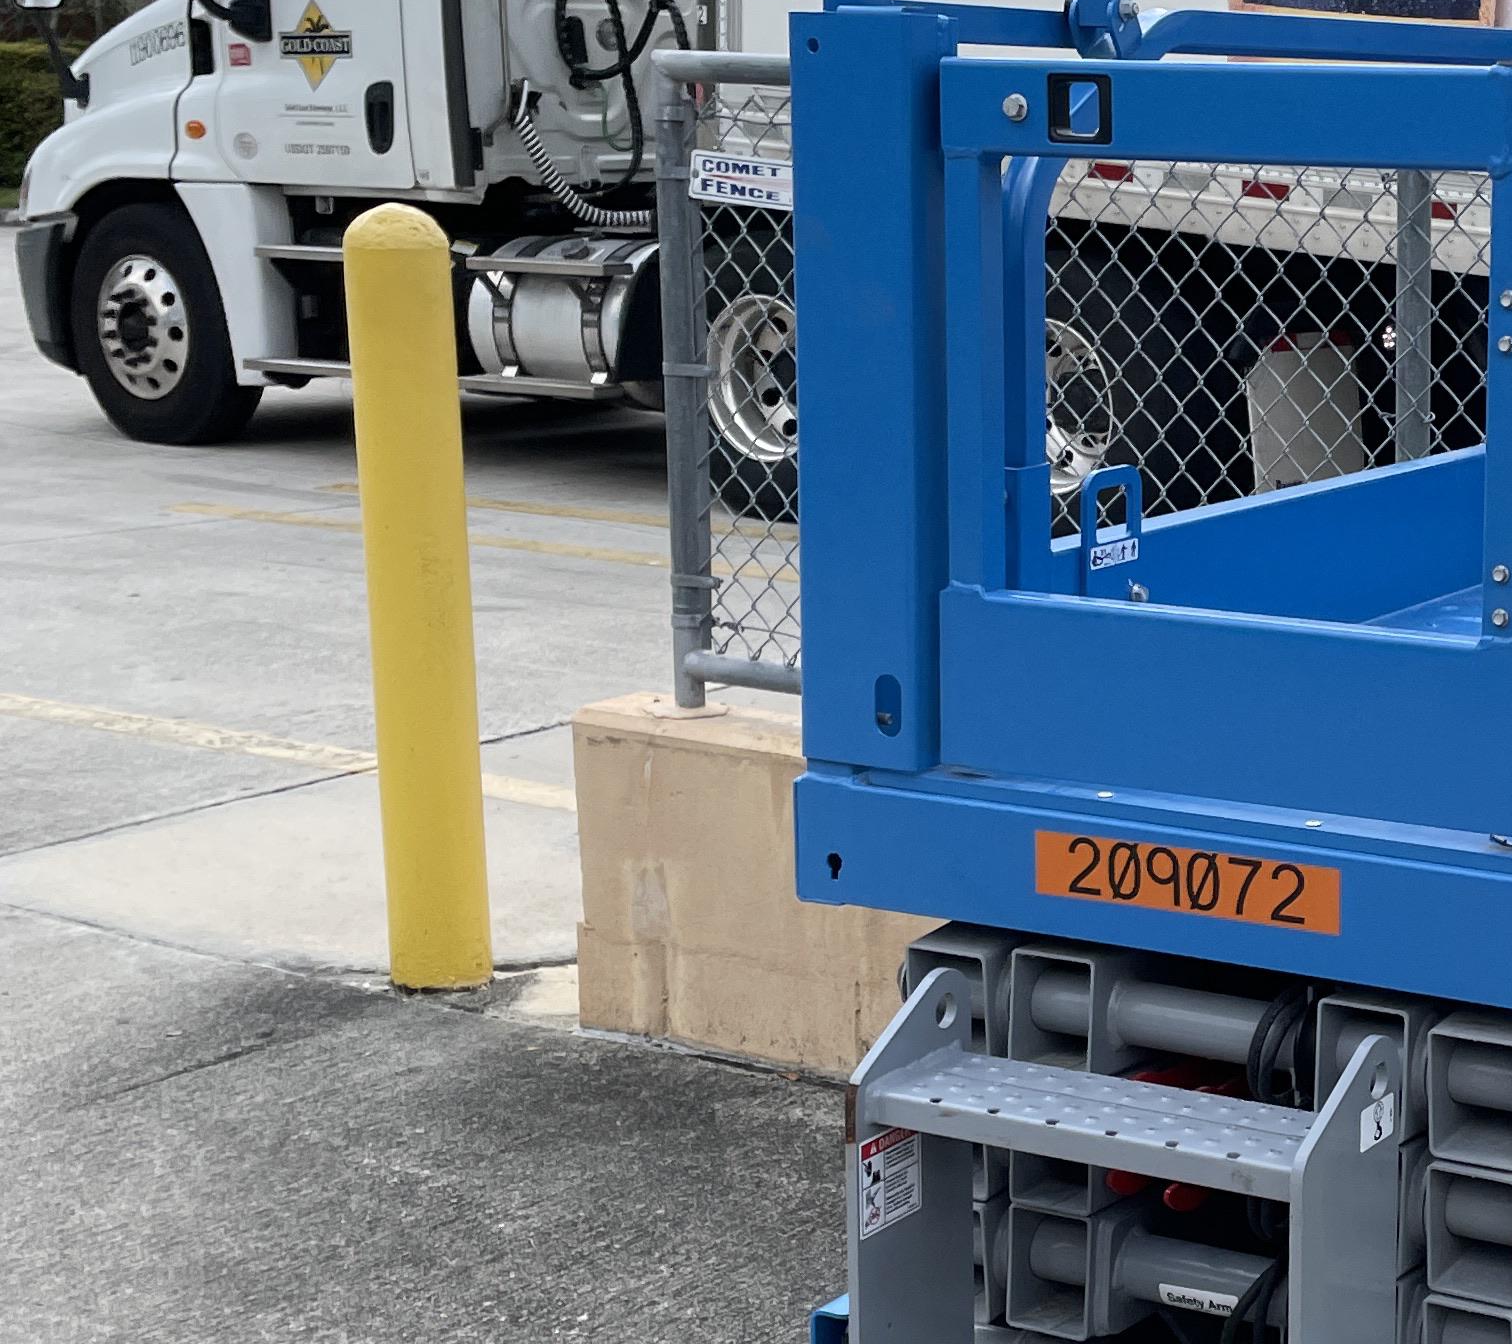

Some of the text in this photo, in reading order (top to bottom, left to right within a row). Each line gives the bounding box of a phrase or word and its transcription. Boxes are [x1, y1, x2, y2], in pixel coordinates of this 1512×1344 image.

[280, 38, 351, 53] GOLD COAST
[702, 159, 781, 177] COMET
[700, 177, 780, 202] FENCE
[1067, 836, 1306, 925] 209072
[1166, 1291, 1233, 1313] Safety Arm
